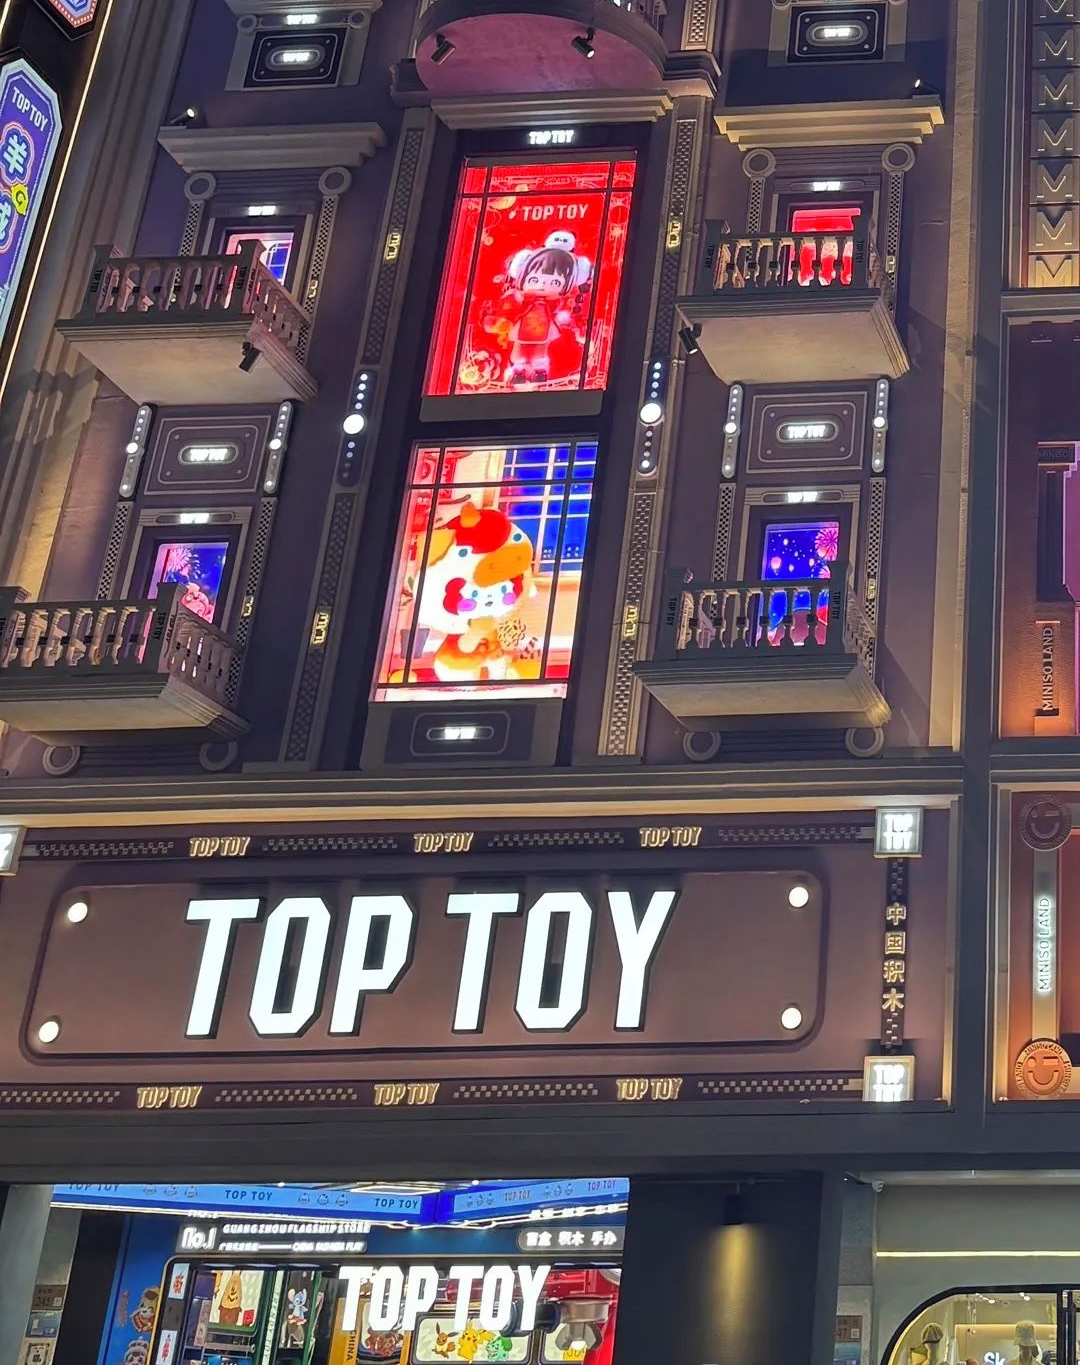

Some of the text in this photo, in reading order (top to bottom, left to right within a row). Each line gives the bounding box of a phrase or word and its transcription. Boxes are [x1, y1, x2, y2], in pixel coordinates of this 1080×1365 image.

[11, 87, 48, 132] TOP TOY
[522, 203, 588, 222] TOP TOY
[1041, 627, 1055, 711] LAND MINISO
[884, 814, 914, 832] TOP
[189, 836, 250, 857] TOP TOY
[414, 832, 474, 853] TOP TOY
[639, 826, 702, 847] TOP TOY
[883, 831, 913, 850] TOY
[1039, 898, 1051, 991] LAND MINISO
[185, 890, 677, 1036] TOP TOY
[881, 902, 907, 1012] 中国积木
[873, 1064, 905, 1084] TOP
[137, 1085, 202, 1108] TOP TOY
[374, 1083, 440, 1105] TOP TOY
[616, 1078, 683, 1100] TOP TOY
[224, 1190, 273, 1201] TOP TOY
[374, 1198, 420, 1209] TOP TOY
[339, 1265, 551, 1332] TOP TOY
[346, 1330, 356, 1361] HINA
